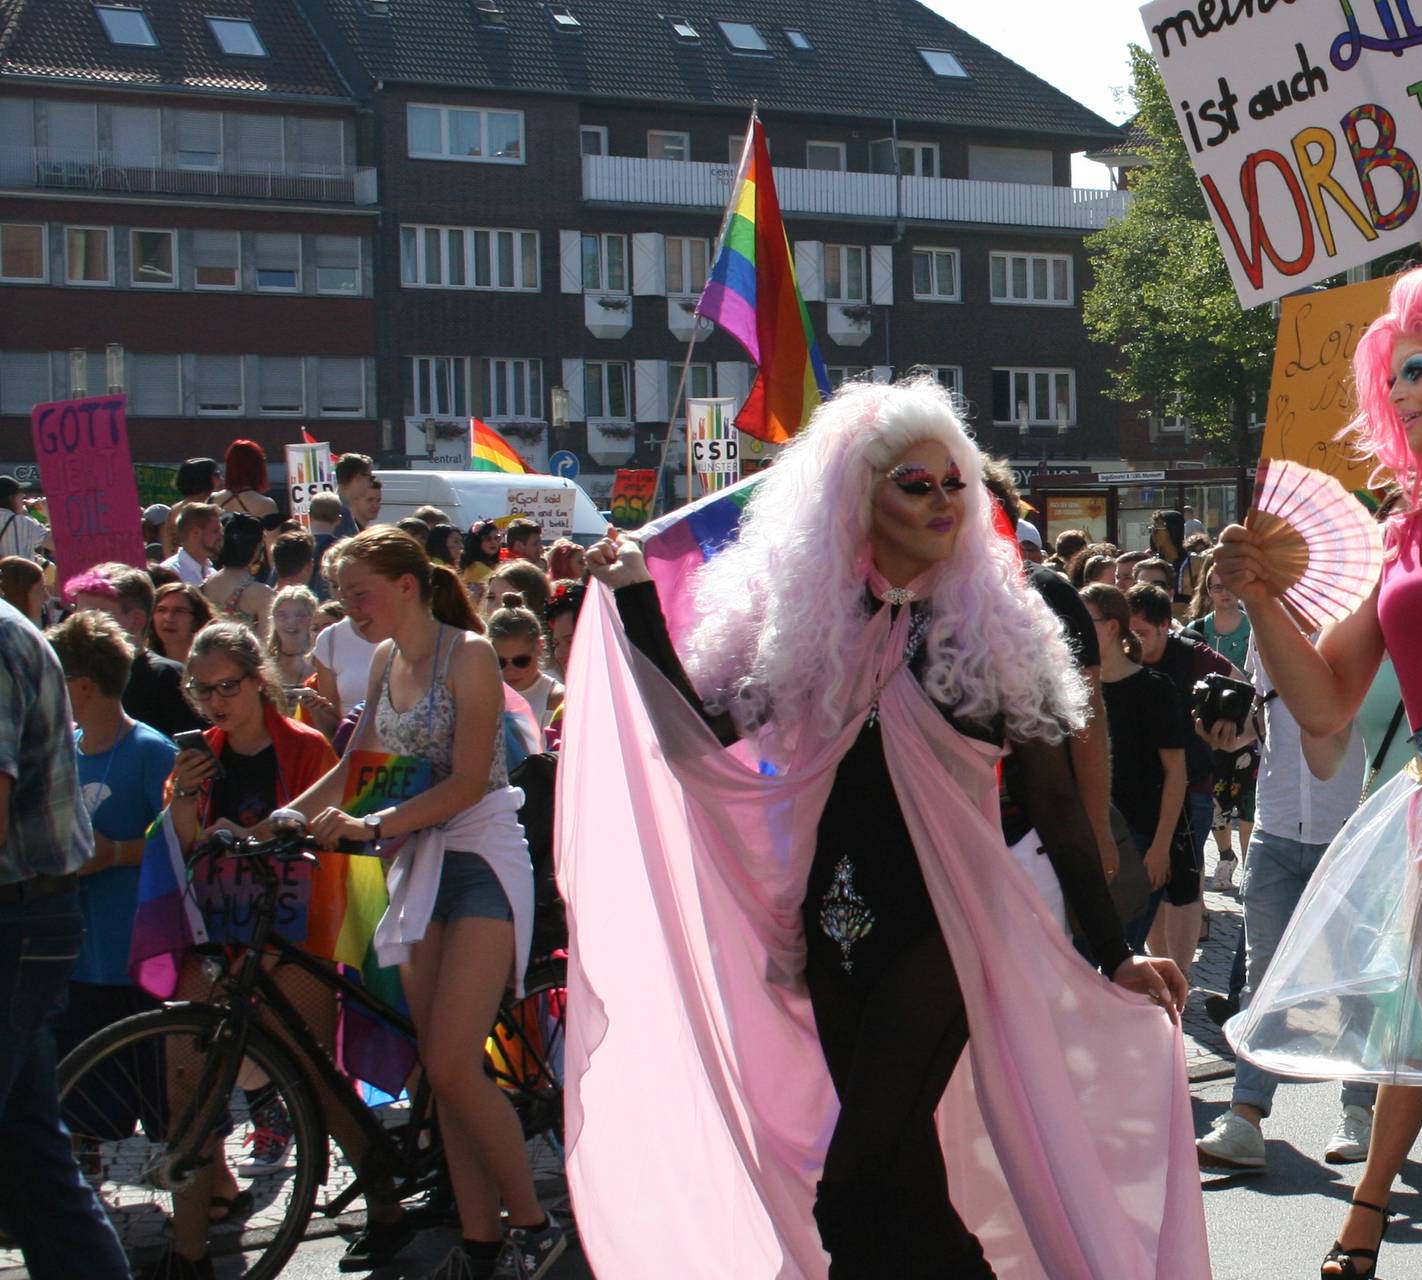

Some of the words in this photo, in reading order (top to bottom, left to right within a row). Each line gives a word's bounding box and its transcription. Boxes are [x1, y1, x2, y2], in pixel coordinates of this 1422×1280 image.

[1152, 0, 1296, 58] mein
[1181, 77, 1240, 153] ist
[1248, 43, 1328, 120] auch
[38, 401, 124, 454] GOTT
[694, 441, 738, 460] CSD
[516, 491, 539, 507] God
[356, 766, 417, 797] FREE
